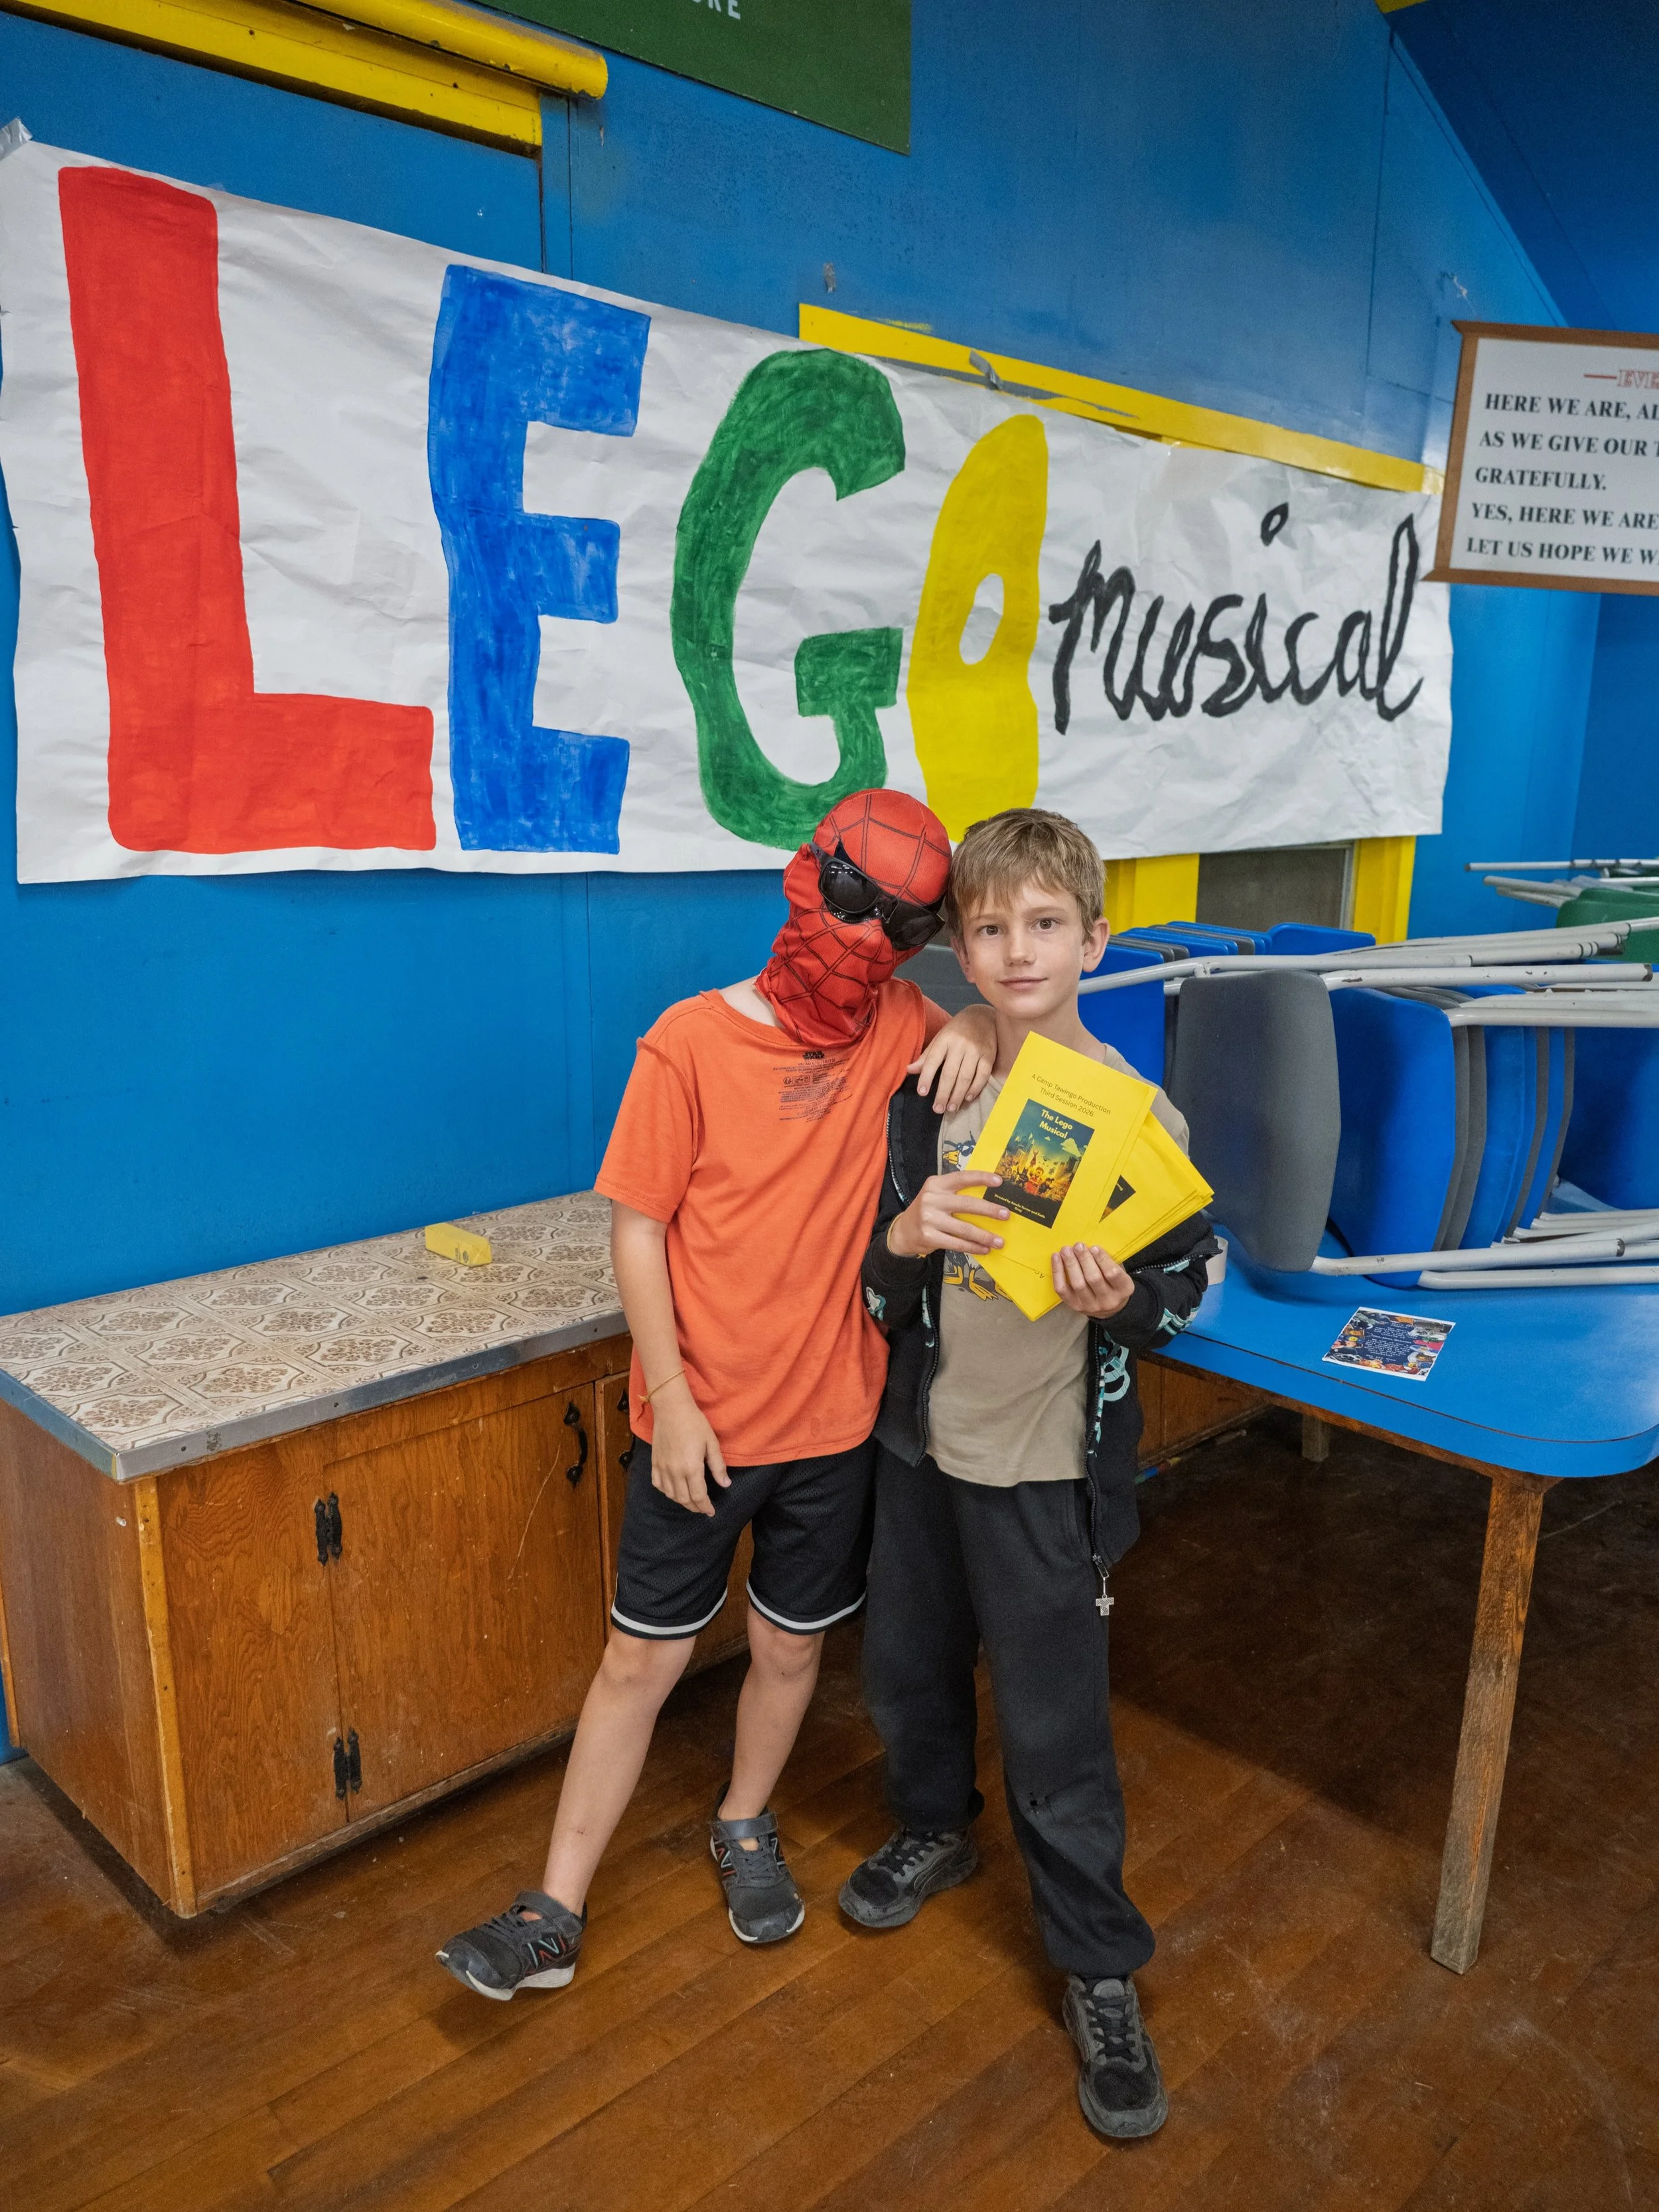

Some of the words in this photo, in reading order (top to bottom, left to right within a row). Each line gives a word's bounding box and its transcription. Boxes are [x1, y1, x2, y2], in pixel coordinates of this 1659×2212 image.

[1484, 393, 1542, 413] HERE
[1548, 396, 1580, 416] WE
[1584, 400, 1630, 423] ARE,
[1479, 431, 1505, 449] AS
[1512, 433, 1544, 451] WE
[1548, 435, 1599, 454] GIVE
[1603, 438, 1647, 457] OUR
[1475, 467, 1607, 491] GRATEFULLY.
[58, 167, 1049, 855] LEGO
[1472, 502, 1512, 524] YES,
[1519, 506, 1576, 525] HERE
[1583, 509, 1615, 528] WE
[1619, 512, 1659, 530] ARE
[1467, 536, 1503, 556] LET
[1508, 540, 1533, 558] US
[1539, 543, 1595, 562] HOPE
[1602, 546, 1632, 565] WE
[1037, 1076, 1053, 1088] Camp
[1054, 1084, 1077, 1099] Tawingo
[1077, 1095, 1112, 1115] Production
[1040, 1087, 1055, 1099] Third
[1055, 1095, 1078, 1110] Session
[1078, 1106, 1094, 1117] 2026
[1039, 1120, 1068, 1139] Musical
[1041, 1109, 1054, 1121] The
[1054, 1116, 1073, 1130] Lego
